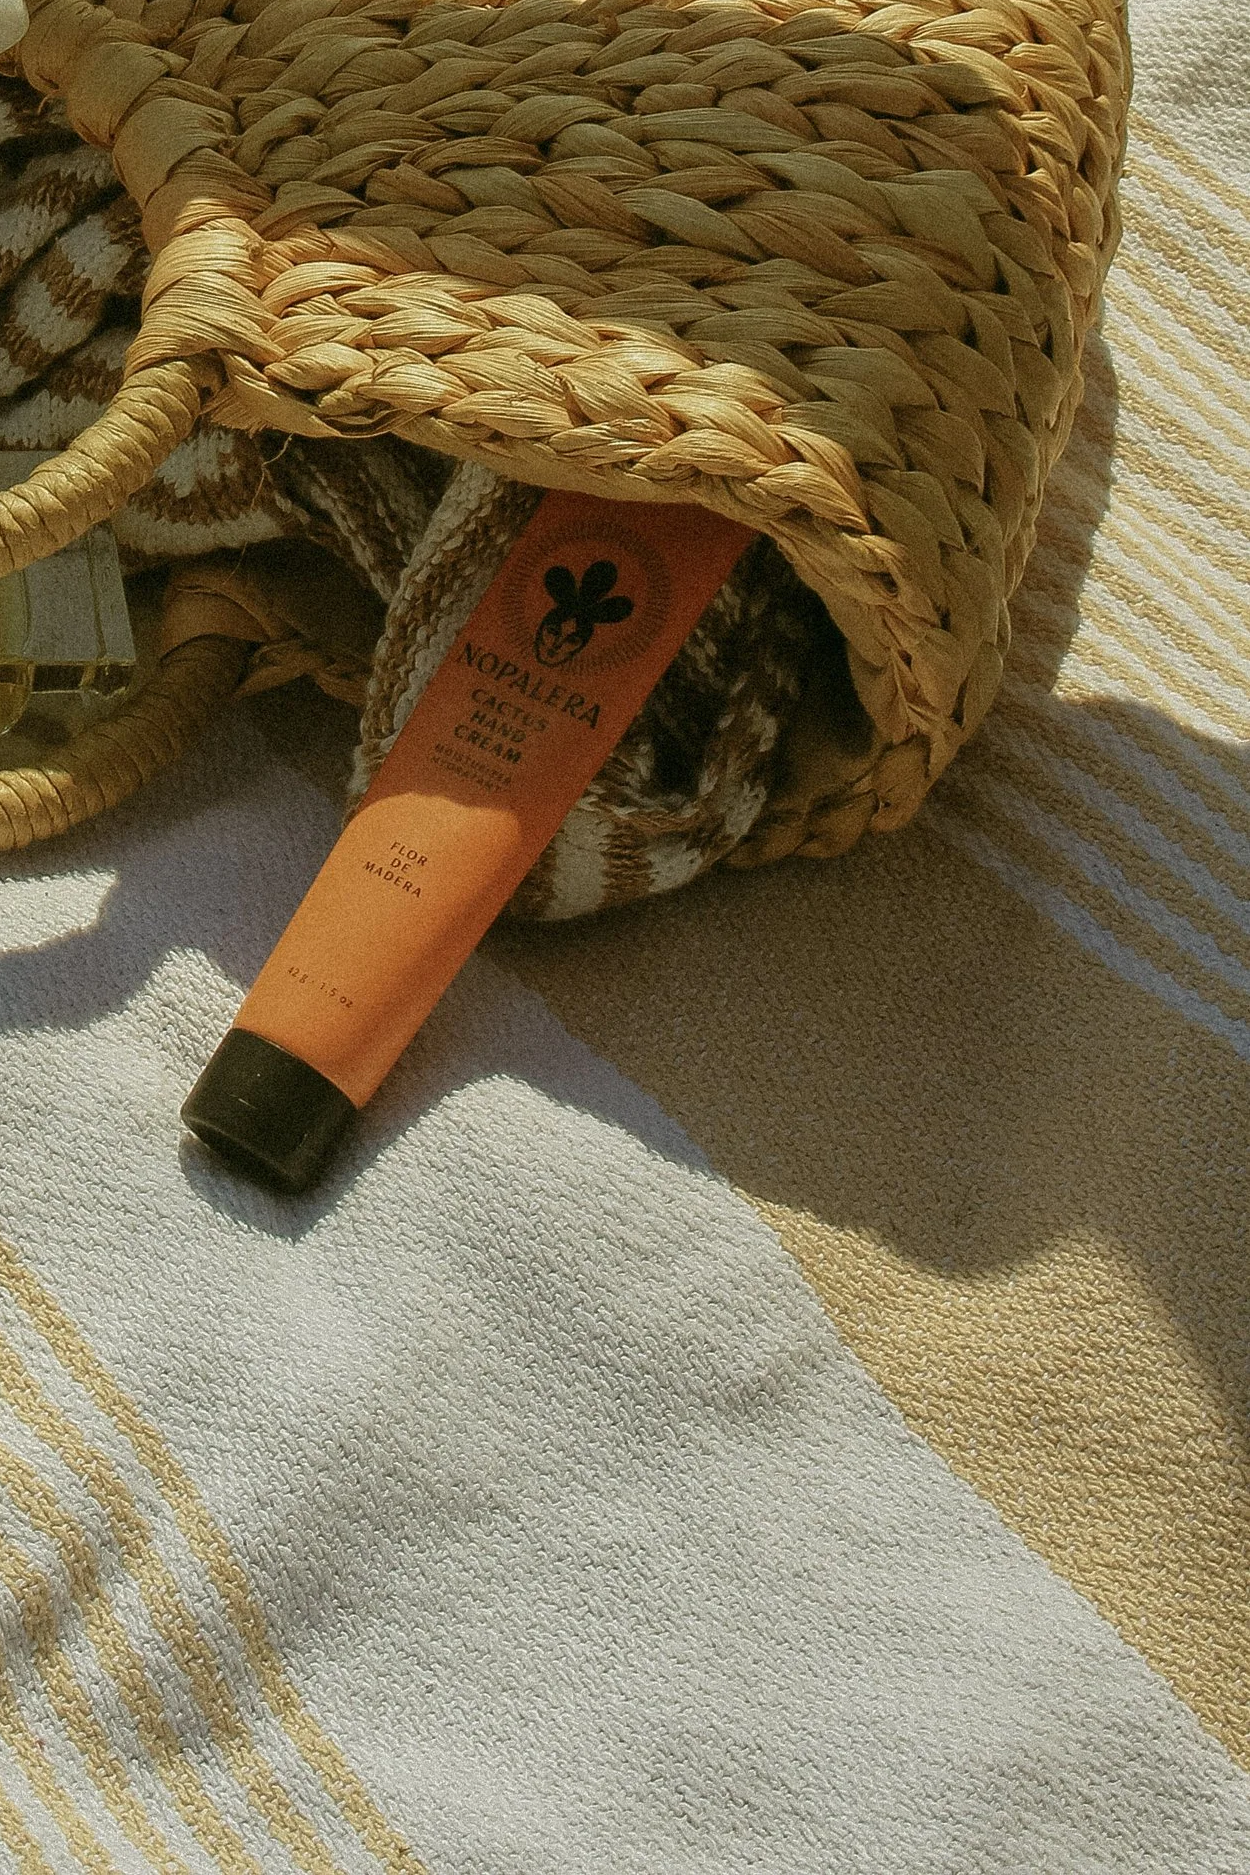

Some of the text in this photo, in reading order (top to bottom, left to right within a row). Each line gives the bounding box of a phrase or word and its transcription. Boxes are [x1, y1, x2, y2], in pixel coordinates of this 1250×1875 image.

[456, 641, 601, 730] NOPALERA
[470, 710, 527, 743] HAND
[471, 688, 547, 732] CACTUS
[454, 724, 522, 765] CREAM
[390, 841, 428, 867] FLOR
[390, 857, 412, 874] DE
[363, 861, 422, 898] MADERA
[339, 995, 353, 1008] oz
